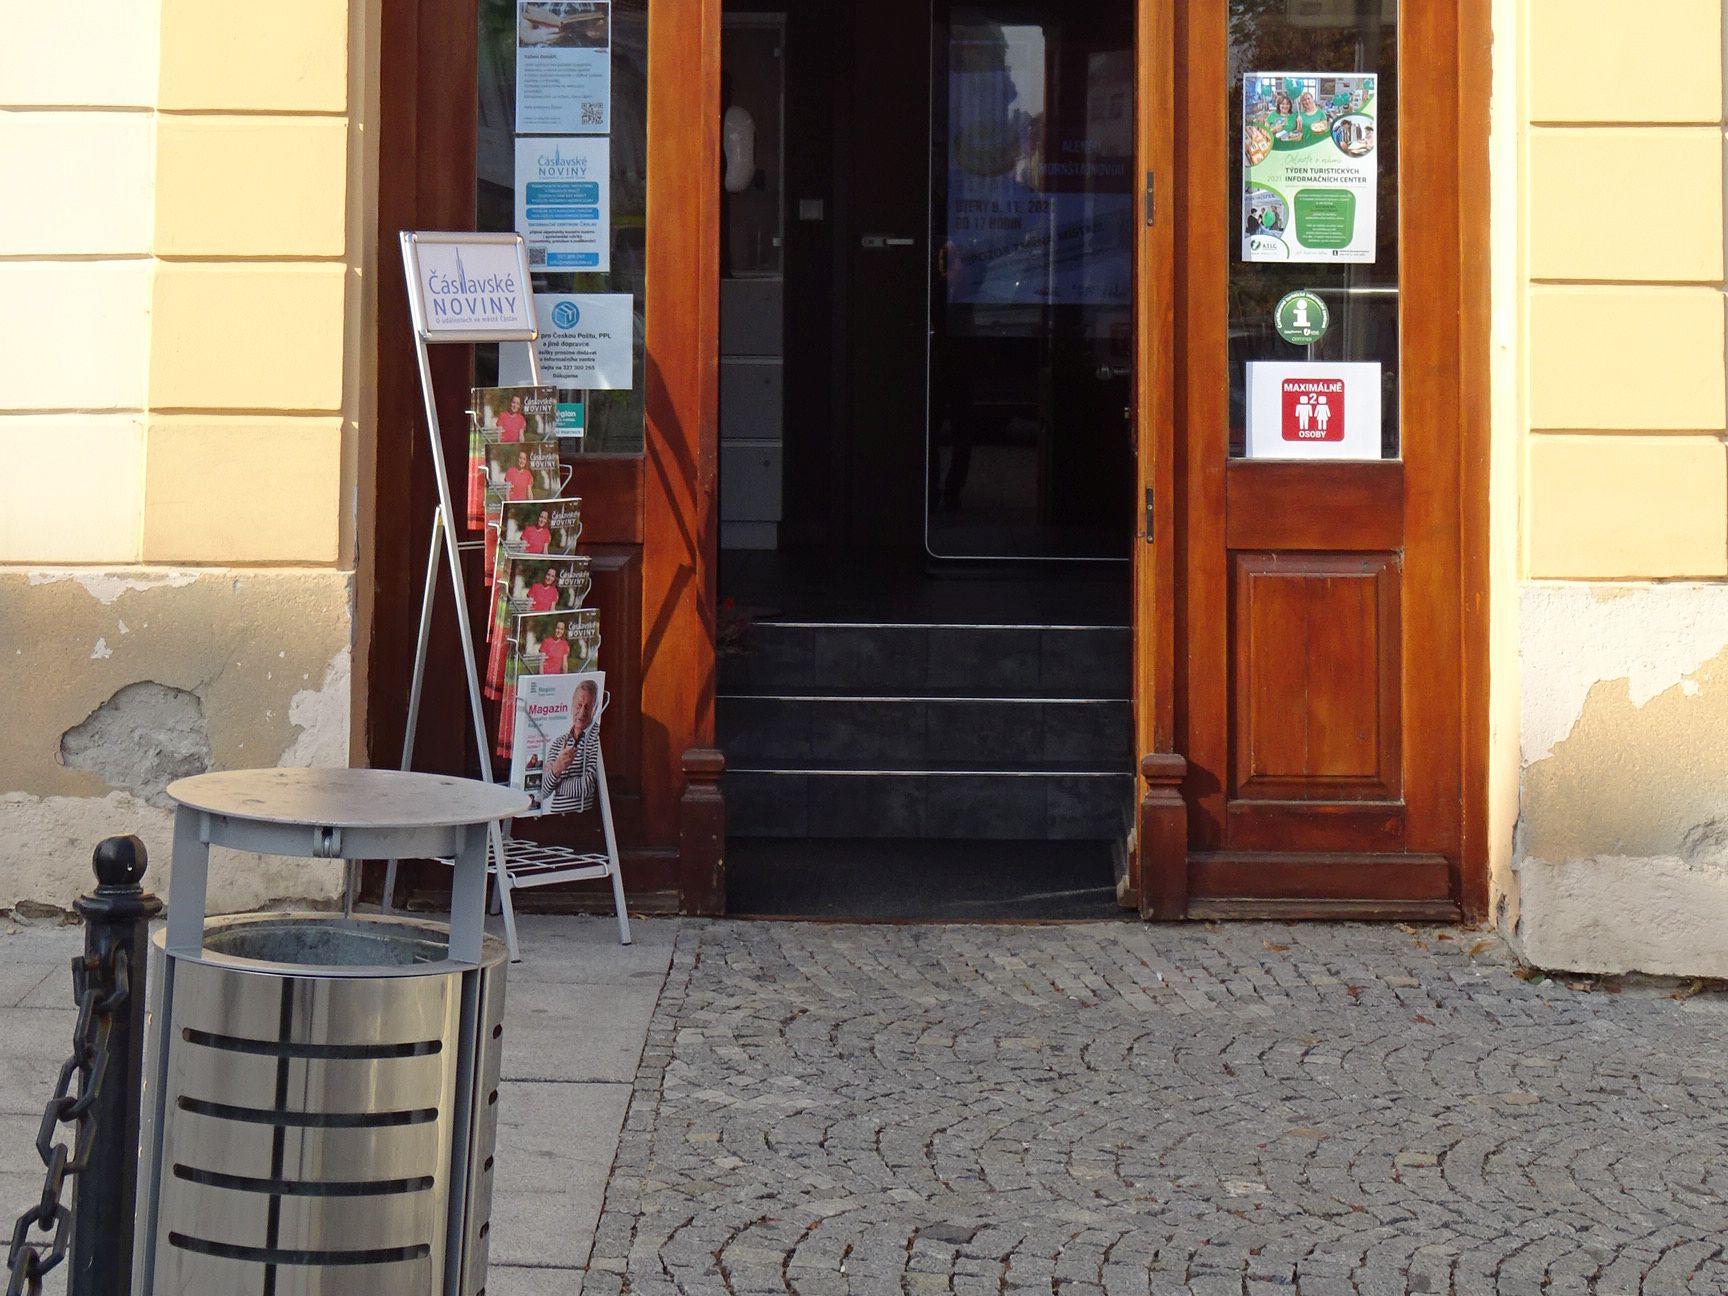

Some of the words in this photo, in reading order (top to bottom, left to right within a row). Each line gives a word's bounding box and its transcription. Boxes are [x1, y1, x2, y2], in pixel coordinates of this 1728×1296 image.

[538, 167, 588, 176] NOVINY
[1285, 167, 1308, 175] TÝDEN
[1309, 167, 1360, 175] TURISTICKÝCH
[1284, 175, 1339, 183] INFORMAČNÍCH
[429, 259, 516, 295] Čáslavské
[433, 296, 516, 316] NOVINY
[553, 331, 577, 339] Českou
[1283, 381, 1343, 393] MAXIMÁLNĚ
[1309, 393, 1317, 404] 2
[524, 405, 553, 413] NOVINY
[1298, 430, 1326, 439] OSOBY
[530, 460, 557, 469] NOVINY
[551, 519, 577, 527] NOVINY
[558, 577, 585, 587] NOVINY
[567, 628, 595, 638] NOVINY
